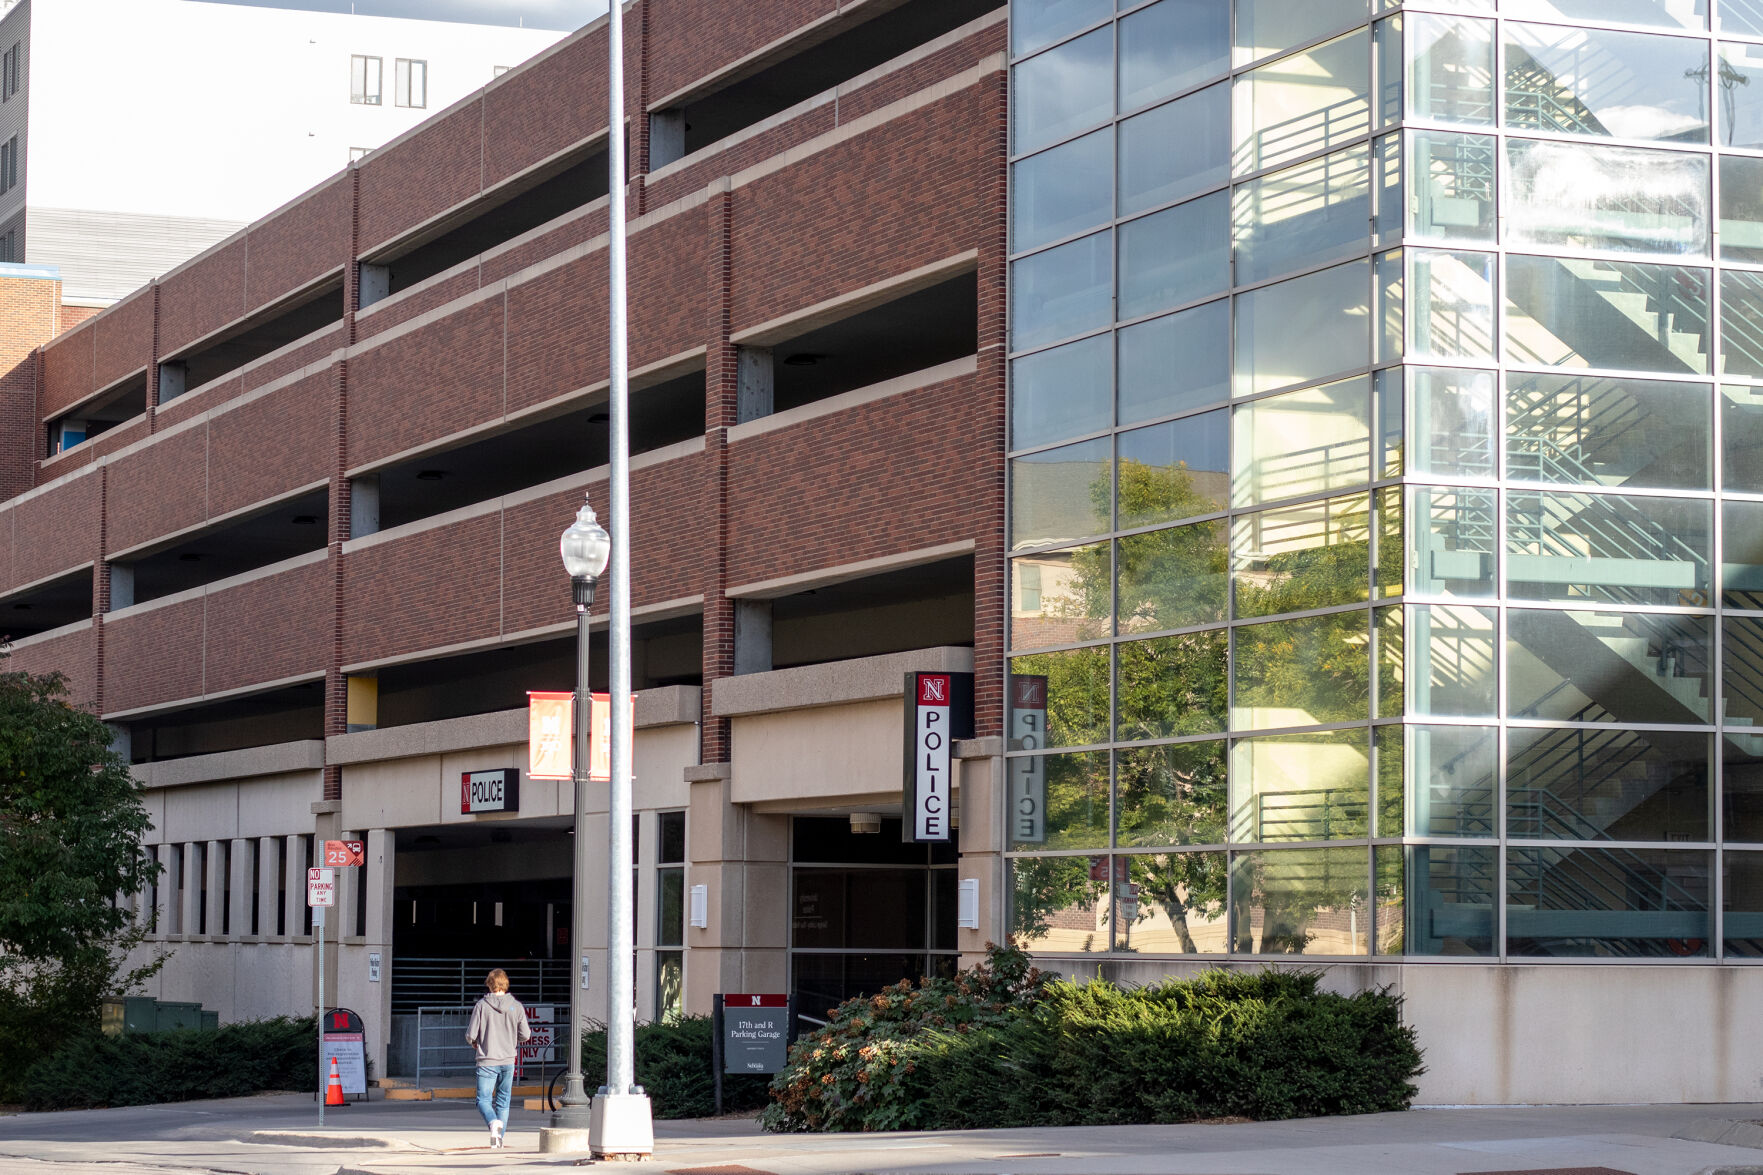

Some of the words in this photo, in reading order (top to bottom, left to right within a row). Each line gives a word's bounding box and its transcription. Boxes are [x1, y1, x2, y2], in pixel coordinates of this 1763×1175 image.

[923, 678, 944, 701] N
[924, 711, 942, 835] POLICE
[471, 780, 503, 803] POLICE
[328, 851, 347, 863] 25
[310, 869, 320, 879] NO
[752, 995, 761, 1006] N
[333, 1012, 350, 1029] N
[738, 1021, 753, 1029] 17th
[754, 1021, 766, 1029] and
[767, 1021, 774, 1029] R
[731, 1030, 757, 1039] Parking
[757, 1030, 781, 1039] Garage
